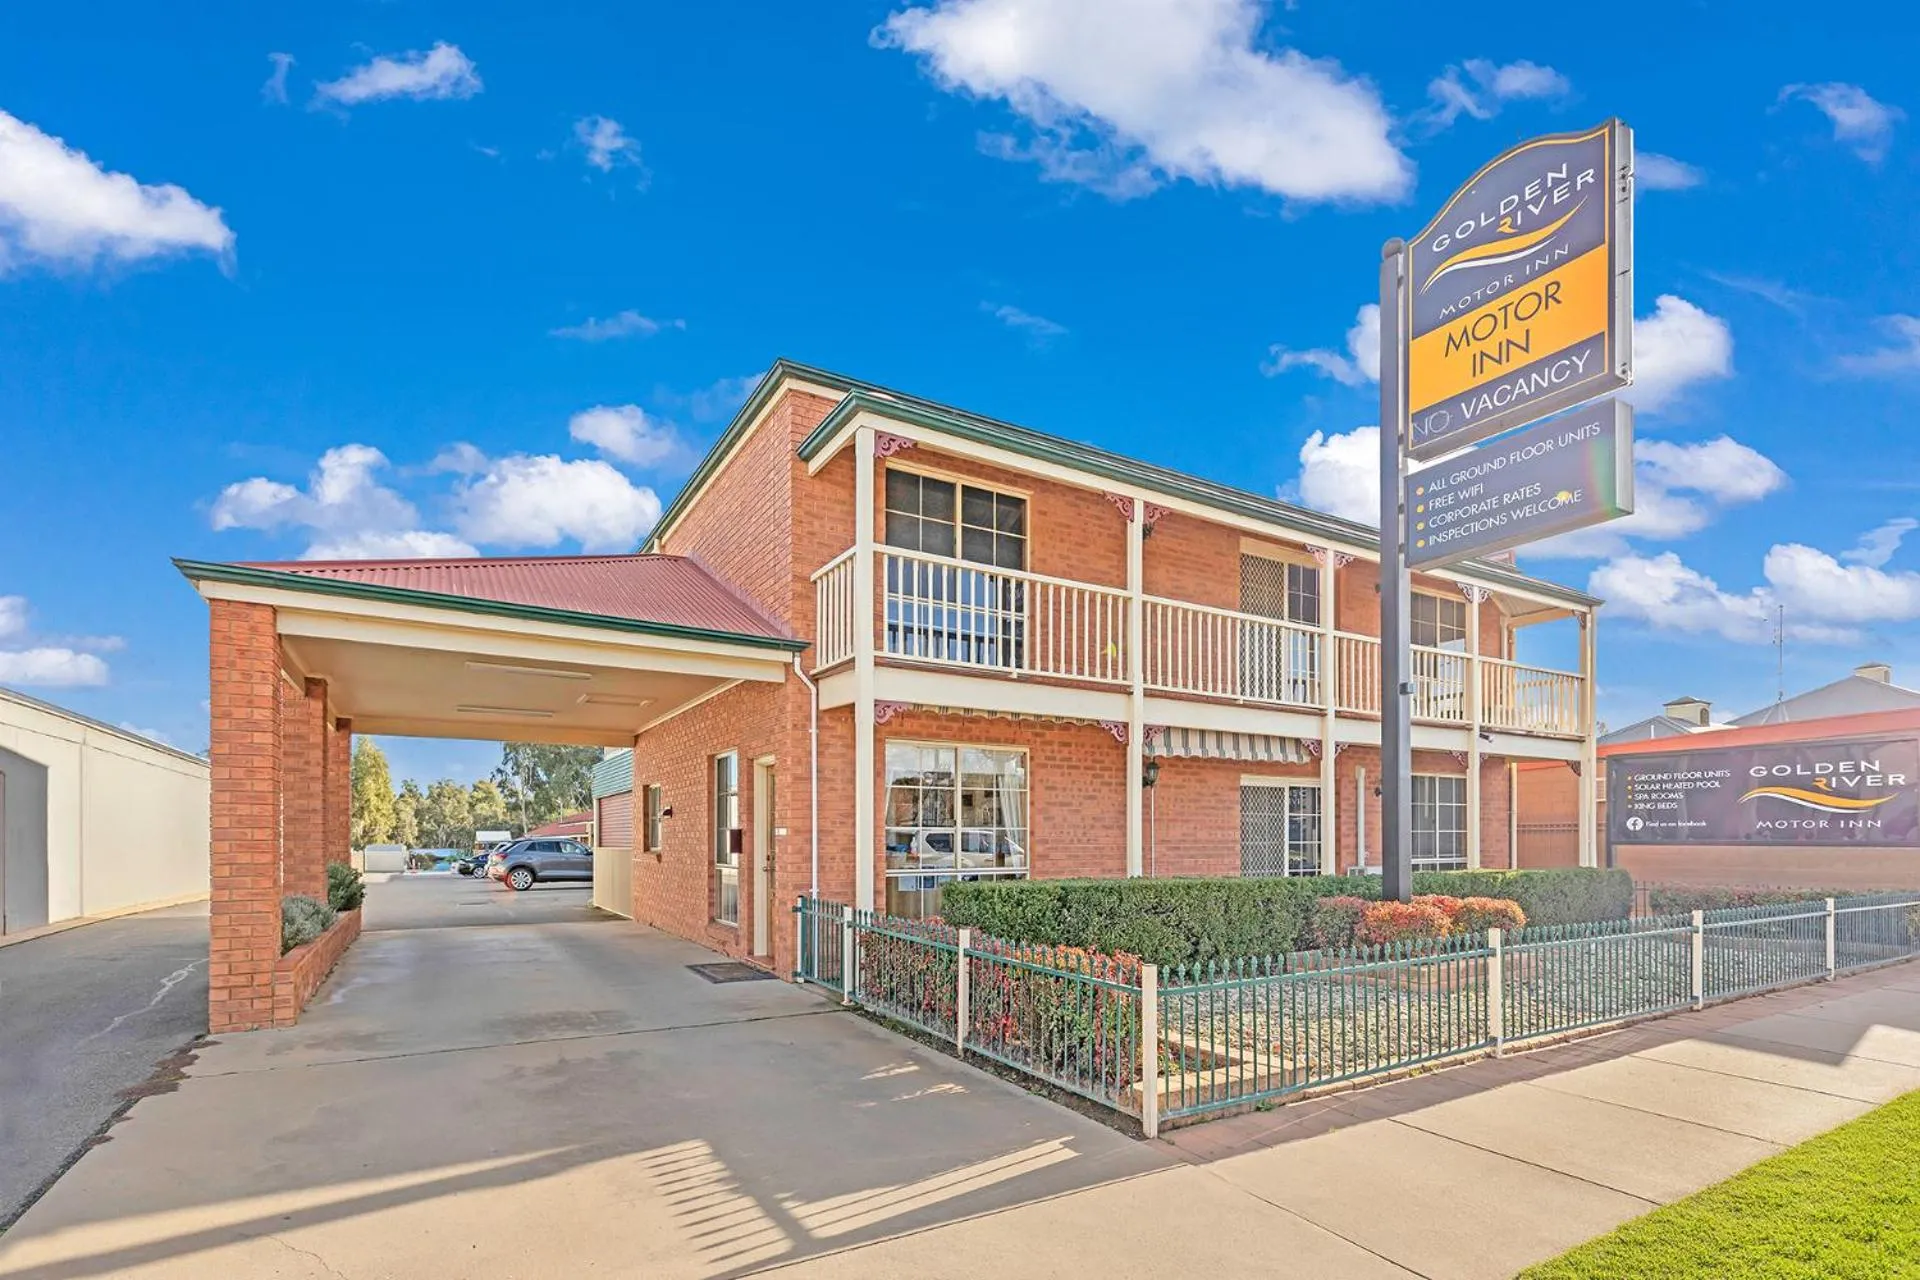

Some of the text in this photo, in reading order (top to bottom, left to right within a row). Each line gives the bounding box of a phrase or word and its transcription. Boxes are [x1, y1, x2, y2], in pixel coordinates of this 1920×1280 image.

[1432, 163, 1568, 252] GOLDEN
[1496, 168, 1595, 233] RIVER
[1439, 244, 1569, 320] MOTOR INN
[1445, 280, 1562, 358] MOTOR
[1472, 328, 1530, 378] INN
[1411, 349, 1591, 440] NO VACANCY
[1428, 422, 1600, 493] ALL GROUND FLOOR UNITS
[1429, 483, 1484, 511] FREE WIFI
[1429, 482, 1541, 528] CORPORATE RATES
[1429, 489, 1583, 546] INSPECTIONS WELCOME
[1634, 770, 1731, 781] GROUND FLOOR UNITS
[1634, 780, 1721, 791] SOLAR HEATED POOL
[1749, 760, 1880, 777] GOLDEN
[1812, 773, 1906, 791] RIVER
[1634, 791, 1684, 801] SPA ROOMS
[1756, 819, 1881, 829] MOTOR INN
